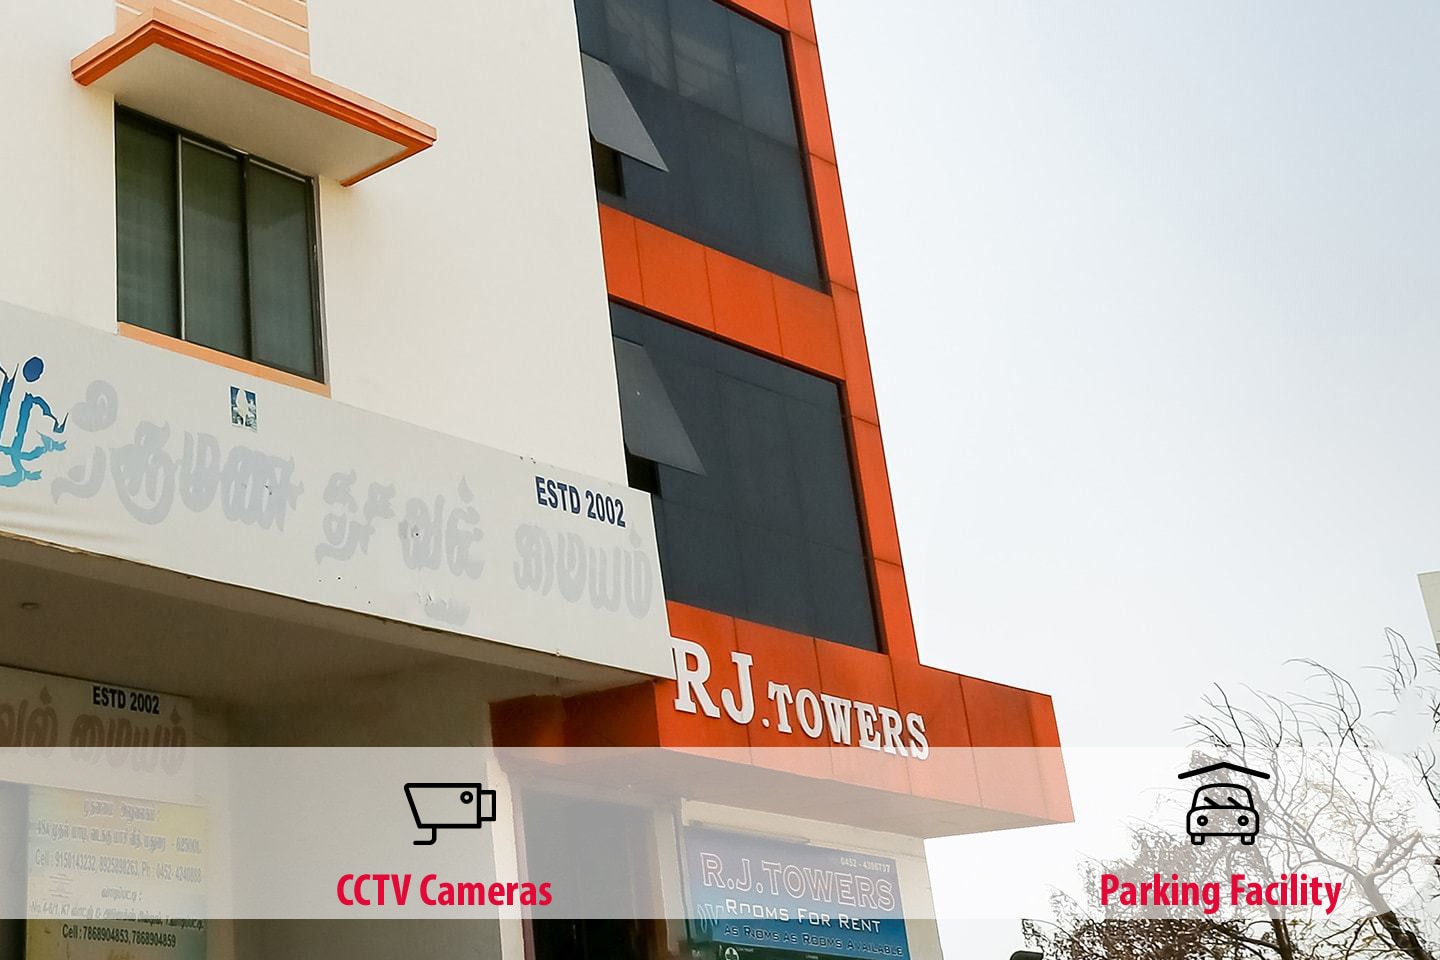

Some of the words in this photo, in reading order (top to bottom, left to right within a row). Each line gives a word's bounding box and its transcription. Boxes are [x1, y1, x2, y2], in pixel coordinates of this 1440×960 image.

[535, 475, 582, 516] ESTD
[585, 490, 627, 528] 2002
[92, 685, 127, 711] ESTD
[129, 691, 161, 715] 2002
